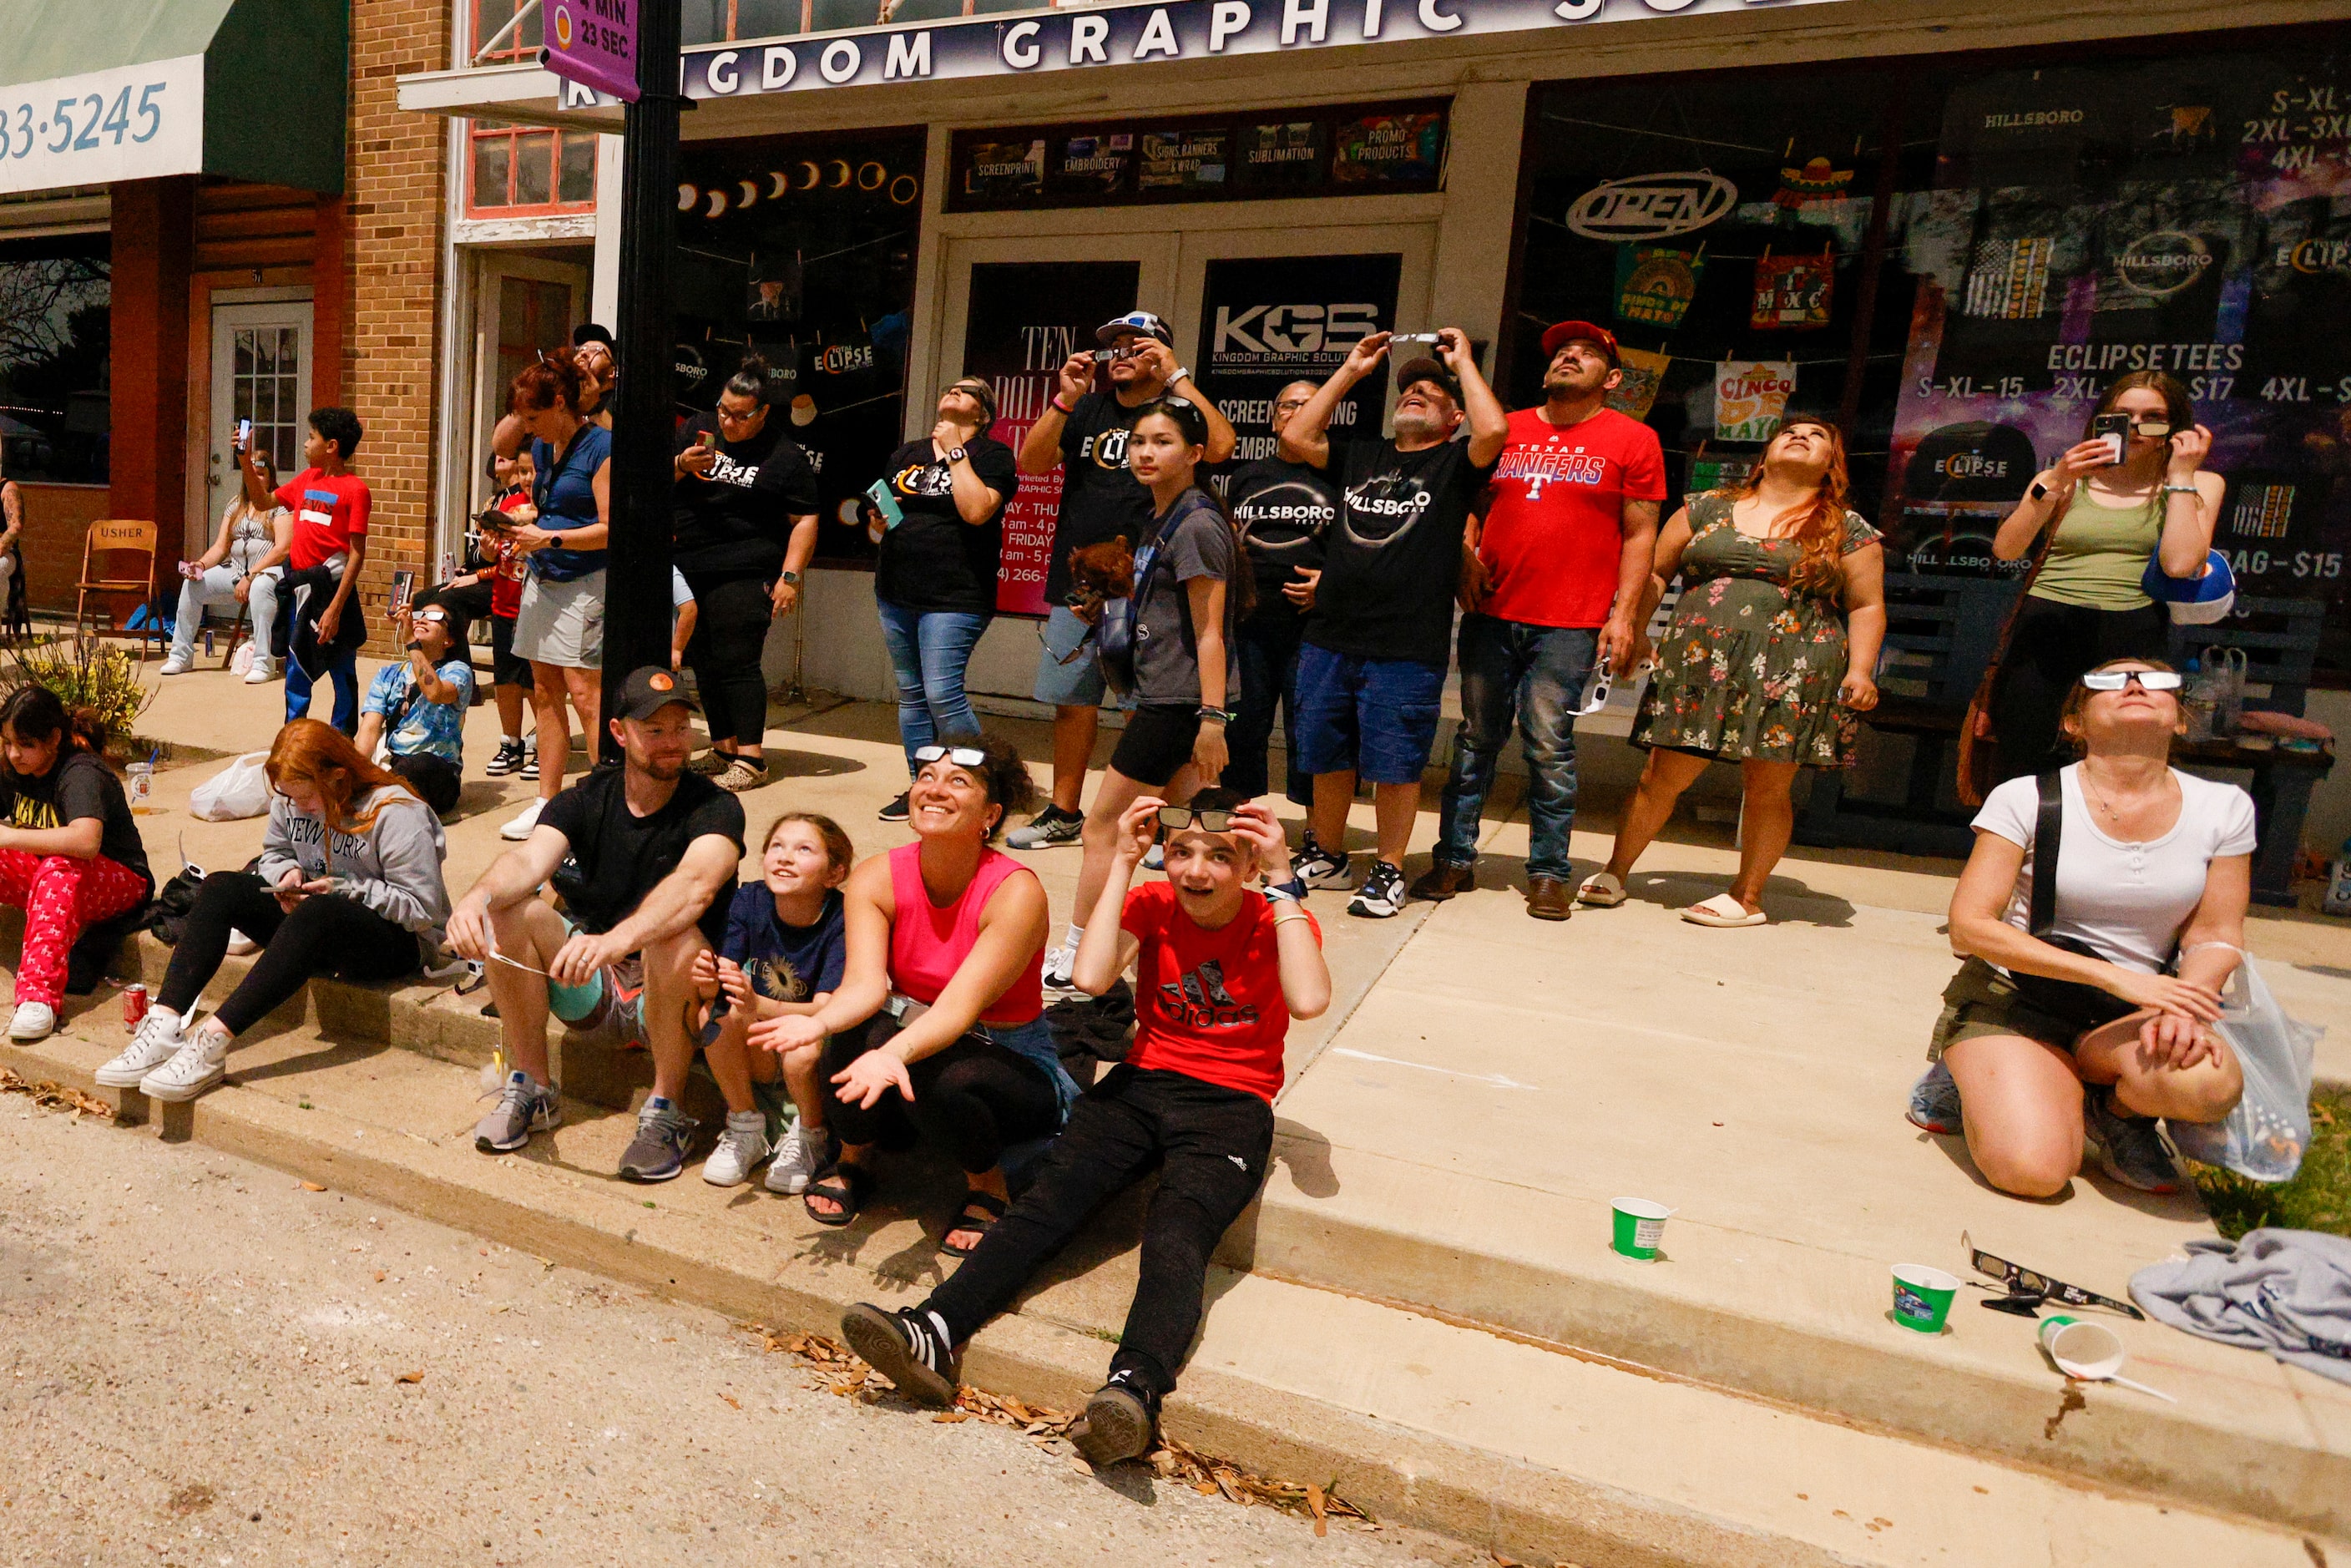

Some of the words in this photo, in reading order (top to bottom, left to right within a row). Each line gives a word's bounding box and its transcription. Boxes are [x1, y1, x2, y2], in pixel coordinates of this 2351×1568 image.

[581, 19, 598, 47] 23
[601, 28, 631, 60] SEC.
[1003, 0, 1463, 68] GRAPHIC
[1368, 130, 1407, 144] PROMO
[1248, 147, 1315, 164] SUBLIMATION
[1358, 144, 1413, 160] PRODUCTS
[978, 161, 1037, 177] SCREENPRINT
[1064, 156, 1121, 173] EMBROIDERY
[1576, 180, 1722, 230] OPEN
[2113, 252, 2212, 268] HILLSBORO
[1213, 303, 1378, 352] KGS
[1021, 326, 1076, 372] TEN
[1211, 353, 1262, 363] KINGDOM
[1263, 352, 1309, 363] GRAPHIC
[2047, 344, 2166, 371] ECLIPSE
[2169, 343, 2243, 371] TEES
[814, 344, 874, 375] ECLIPSE
[1720, 377, 1791, 401] CINCO
[1716, 392, 1787, 425] DE
[1518, 443, 1585, 454] TEXAS
[1494, 452, 1605, 485] RANGERS
[1934, 452, 2009, 478] ECLIPSE
[1053, 475, 1064, 486] By
[1234, 505, 1337, 520] HILLSBORO
[101, 528, 142, 538] USHER
[1008, 519, 1027, 530] am
[1036, 518, 1045, 531] 4
[1009, 534, 1054, 548] FRIDAY
[1005, 551, 1024, 562] am
[1034, 549, 1043, 563] 5
[286, 817, 325, 845] NEW
